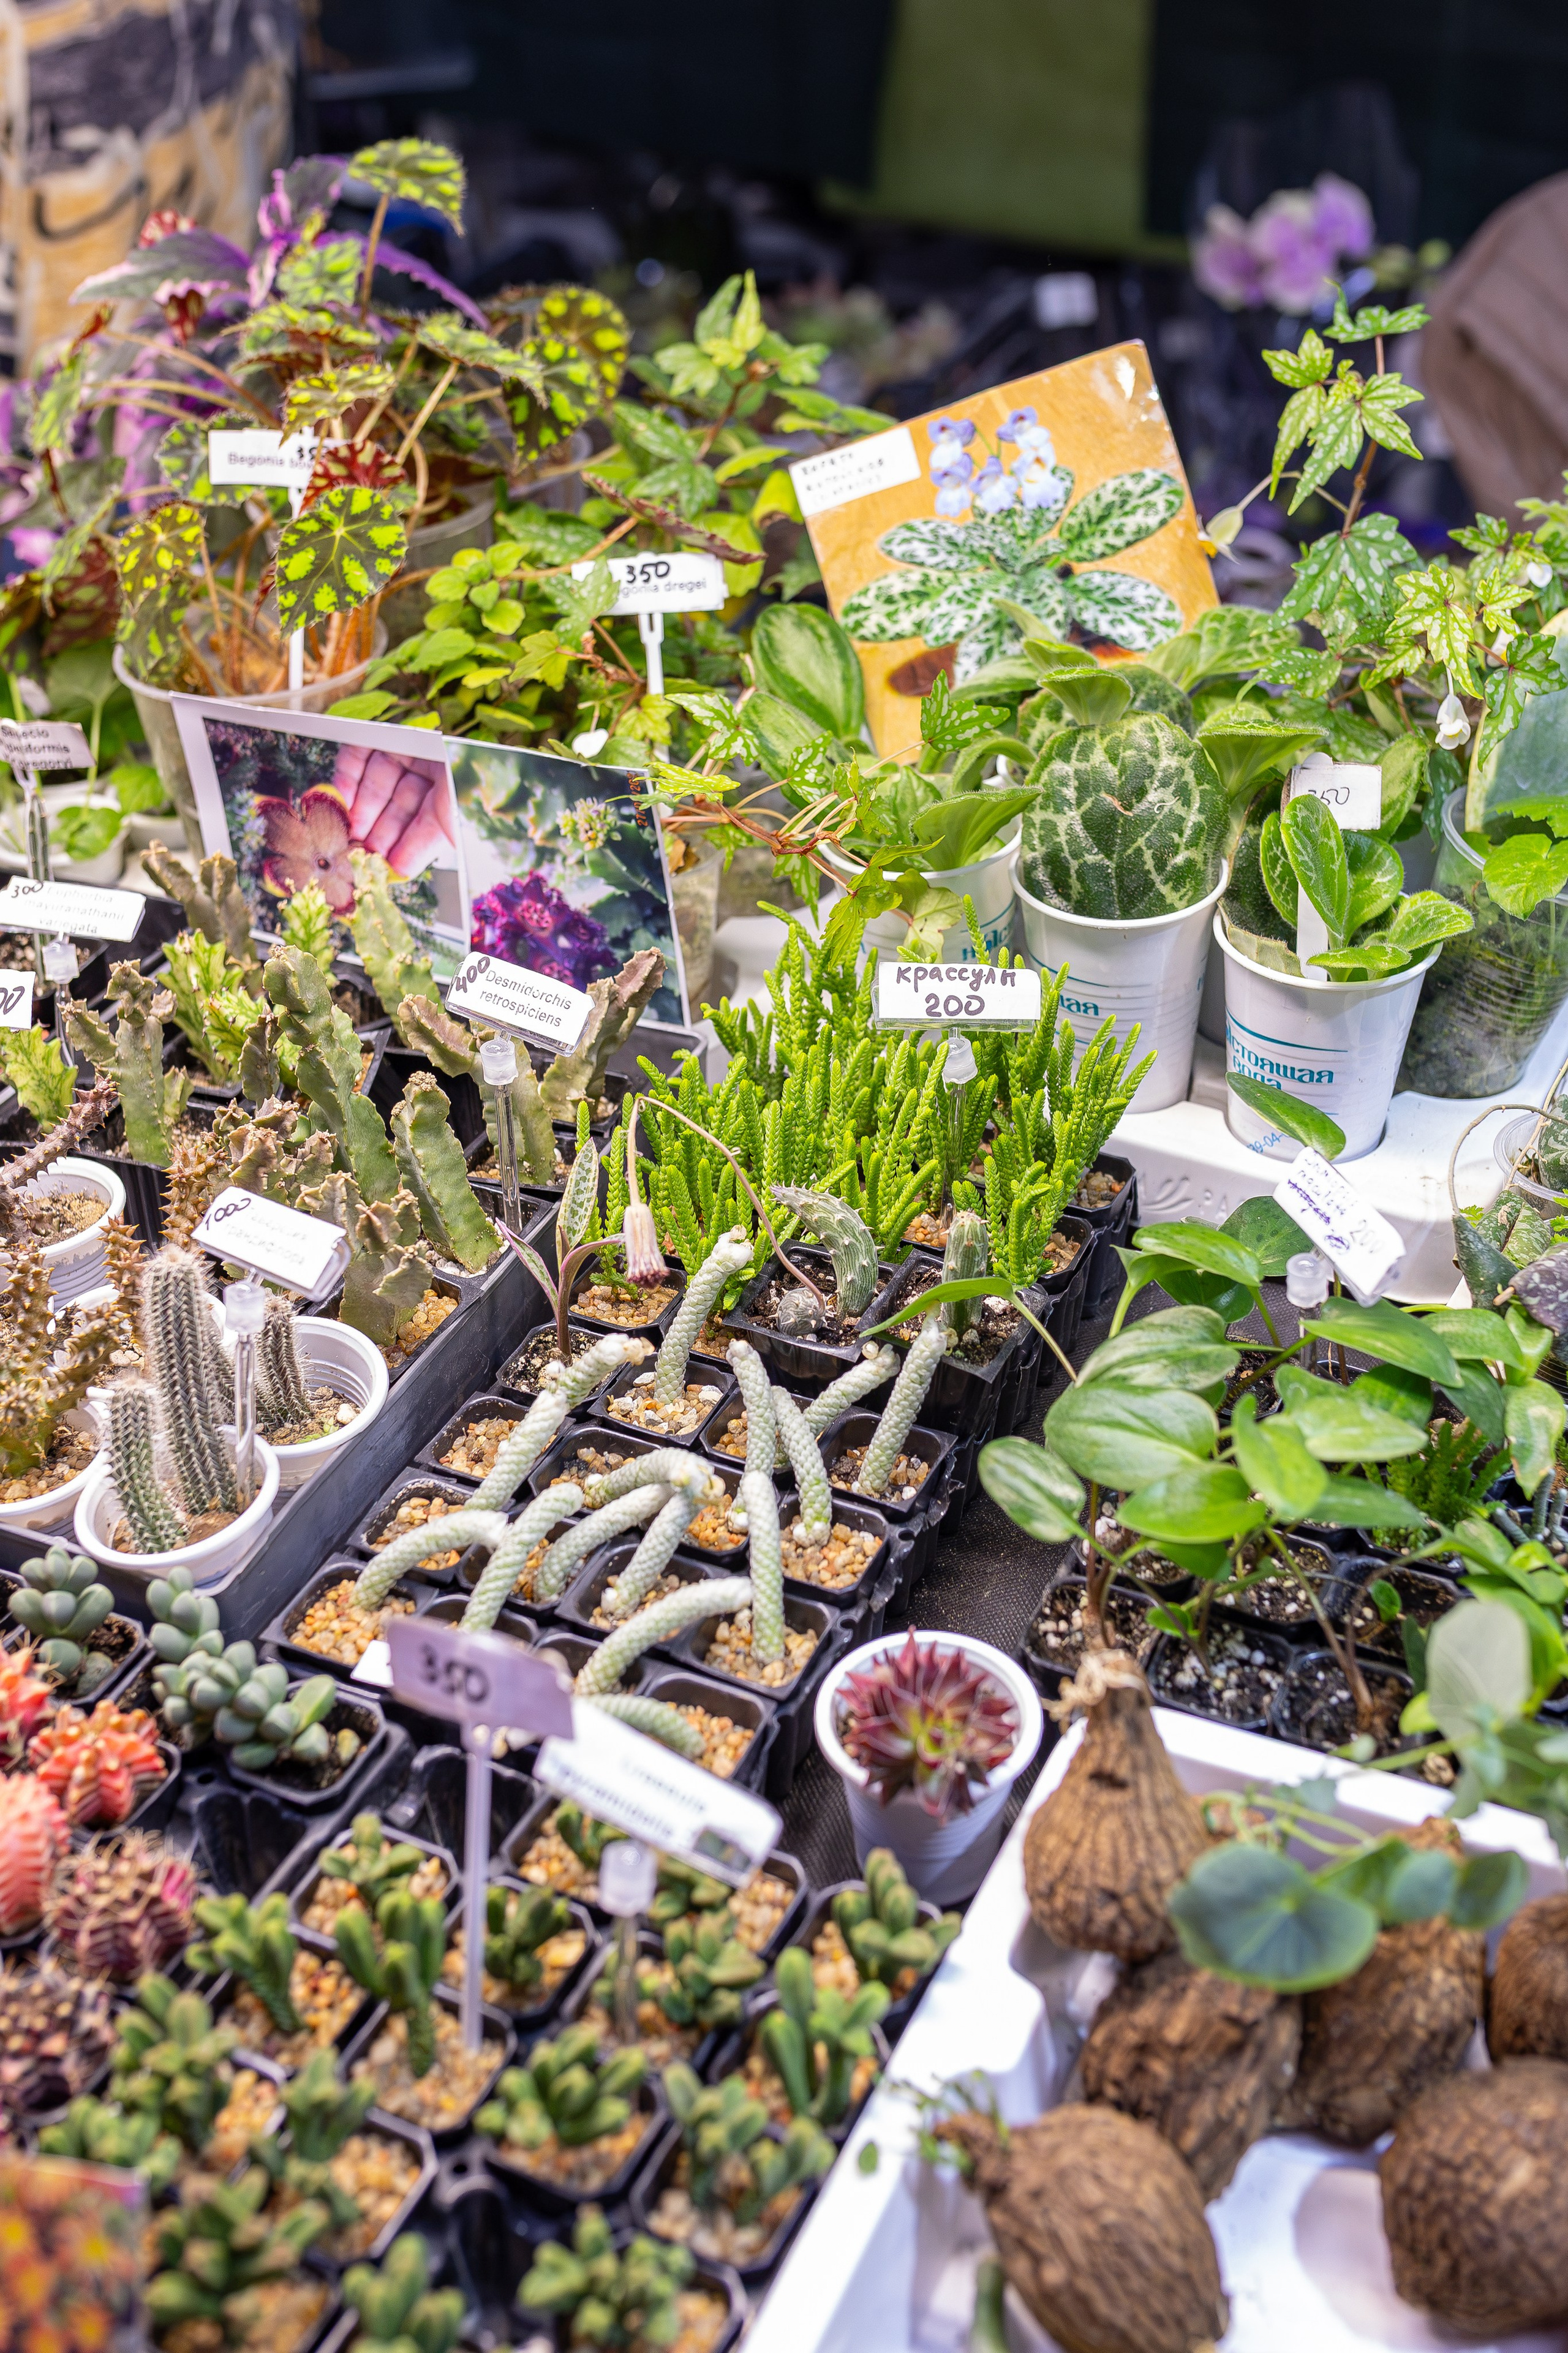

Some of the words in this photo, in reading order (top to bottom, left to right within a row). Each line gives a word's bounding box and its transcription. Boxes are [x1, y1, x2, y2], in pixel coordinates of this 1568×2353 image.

[228, 451, 285, 468] Begonia
[626, 561, 670, 583] 350
[620, 584, 659, 598] gonia
[1308, 787, 1350, 806] 50
[10, 881, 43, 899] 300
[47, 886, 114, 904] Euphorbia
[455, 956, 491, 994] 400
[485, 970, 572, 1010] Desmidorchis
[480, 989, 562, 1027] retrospiciens
[925, 992, 985, 1018] 200
[205, 1197, 252, 1231] 1000
[420, 1643, 491, 1704] 350
